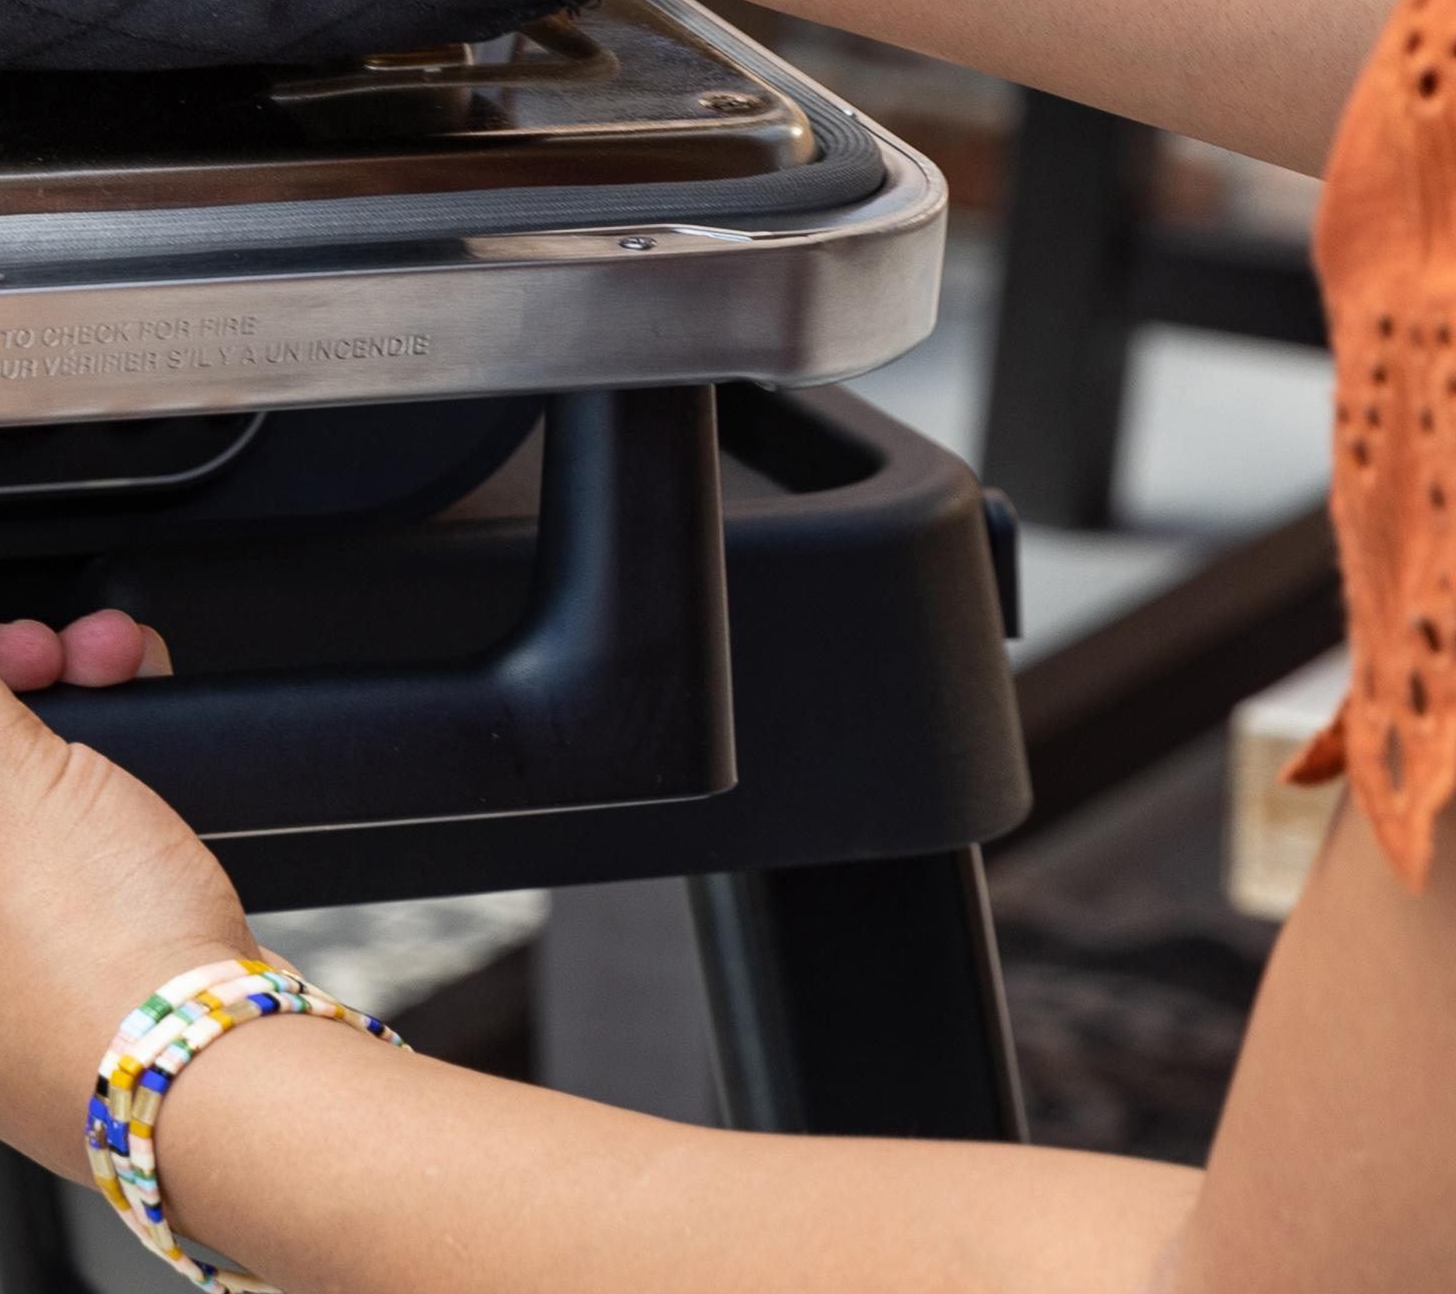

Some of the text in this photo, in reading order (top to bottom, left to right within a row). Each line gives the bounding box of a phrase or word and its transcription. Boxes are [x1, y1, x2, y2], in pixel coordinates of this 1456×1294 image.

[0, 328, 36, 350] TO
[42, 322, 131, 348] CHECK
[139, 319, 191, 342] FOR
[199, 315, 259, 337] FIRE
[43, 349, 158, 377] VÉRIFIER
[241, 344, 259, 366] A
[265, 340, 301, 364] UN
[308, 333, 431, 361] INCENDIE
